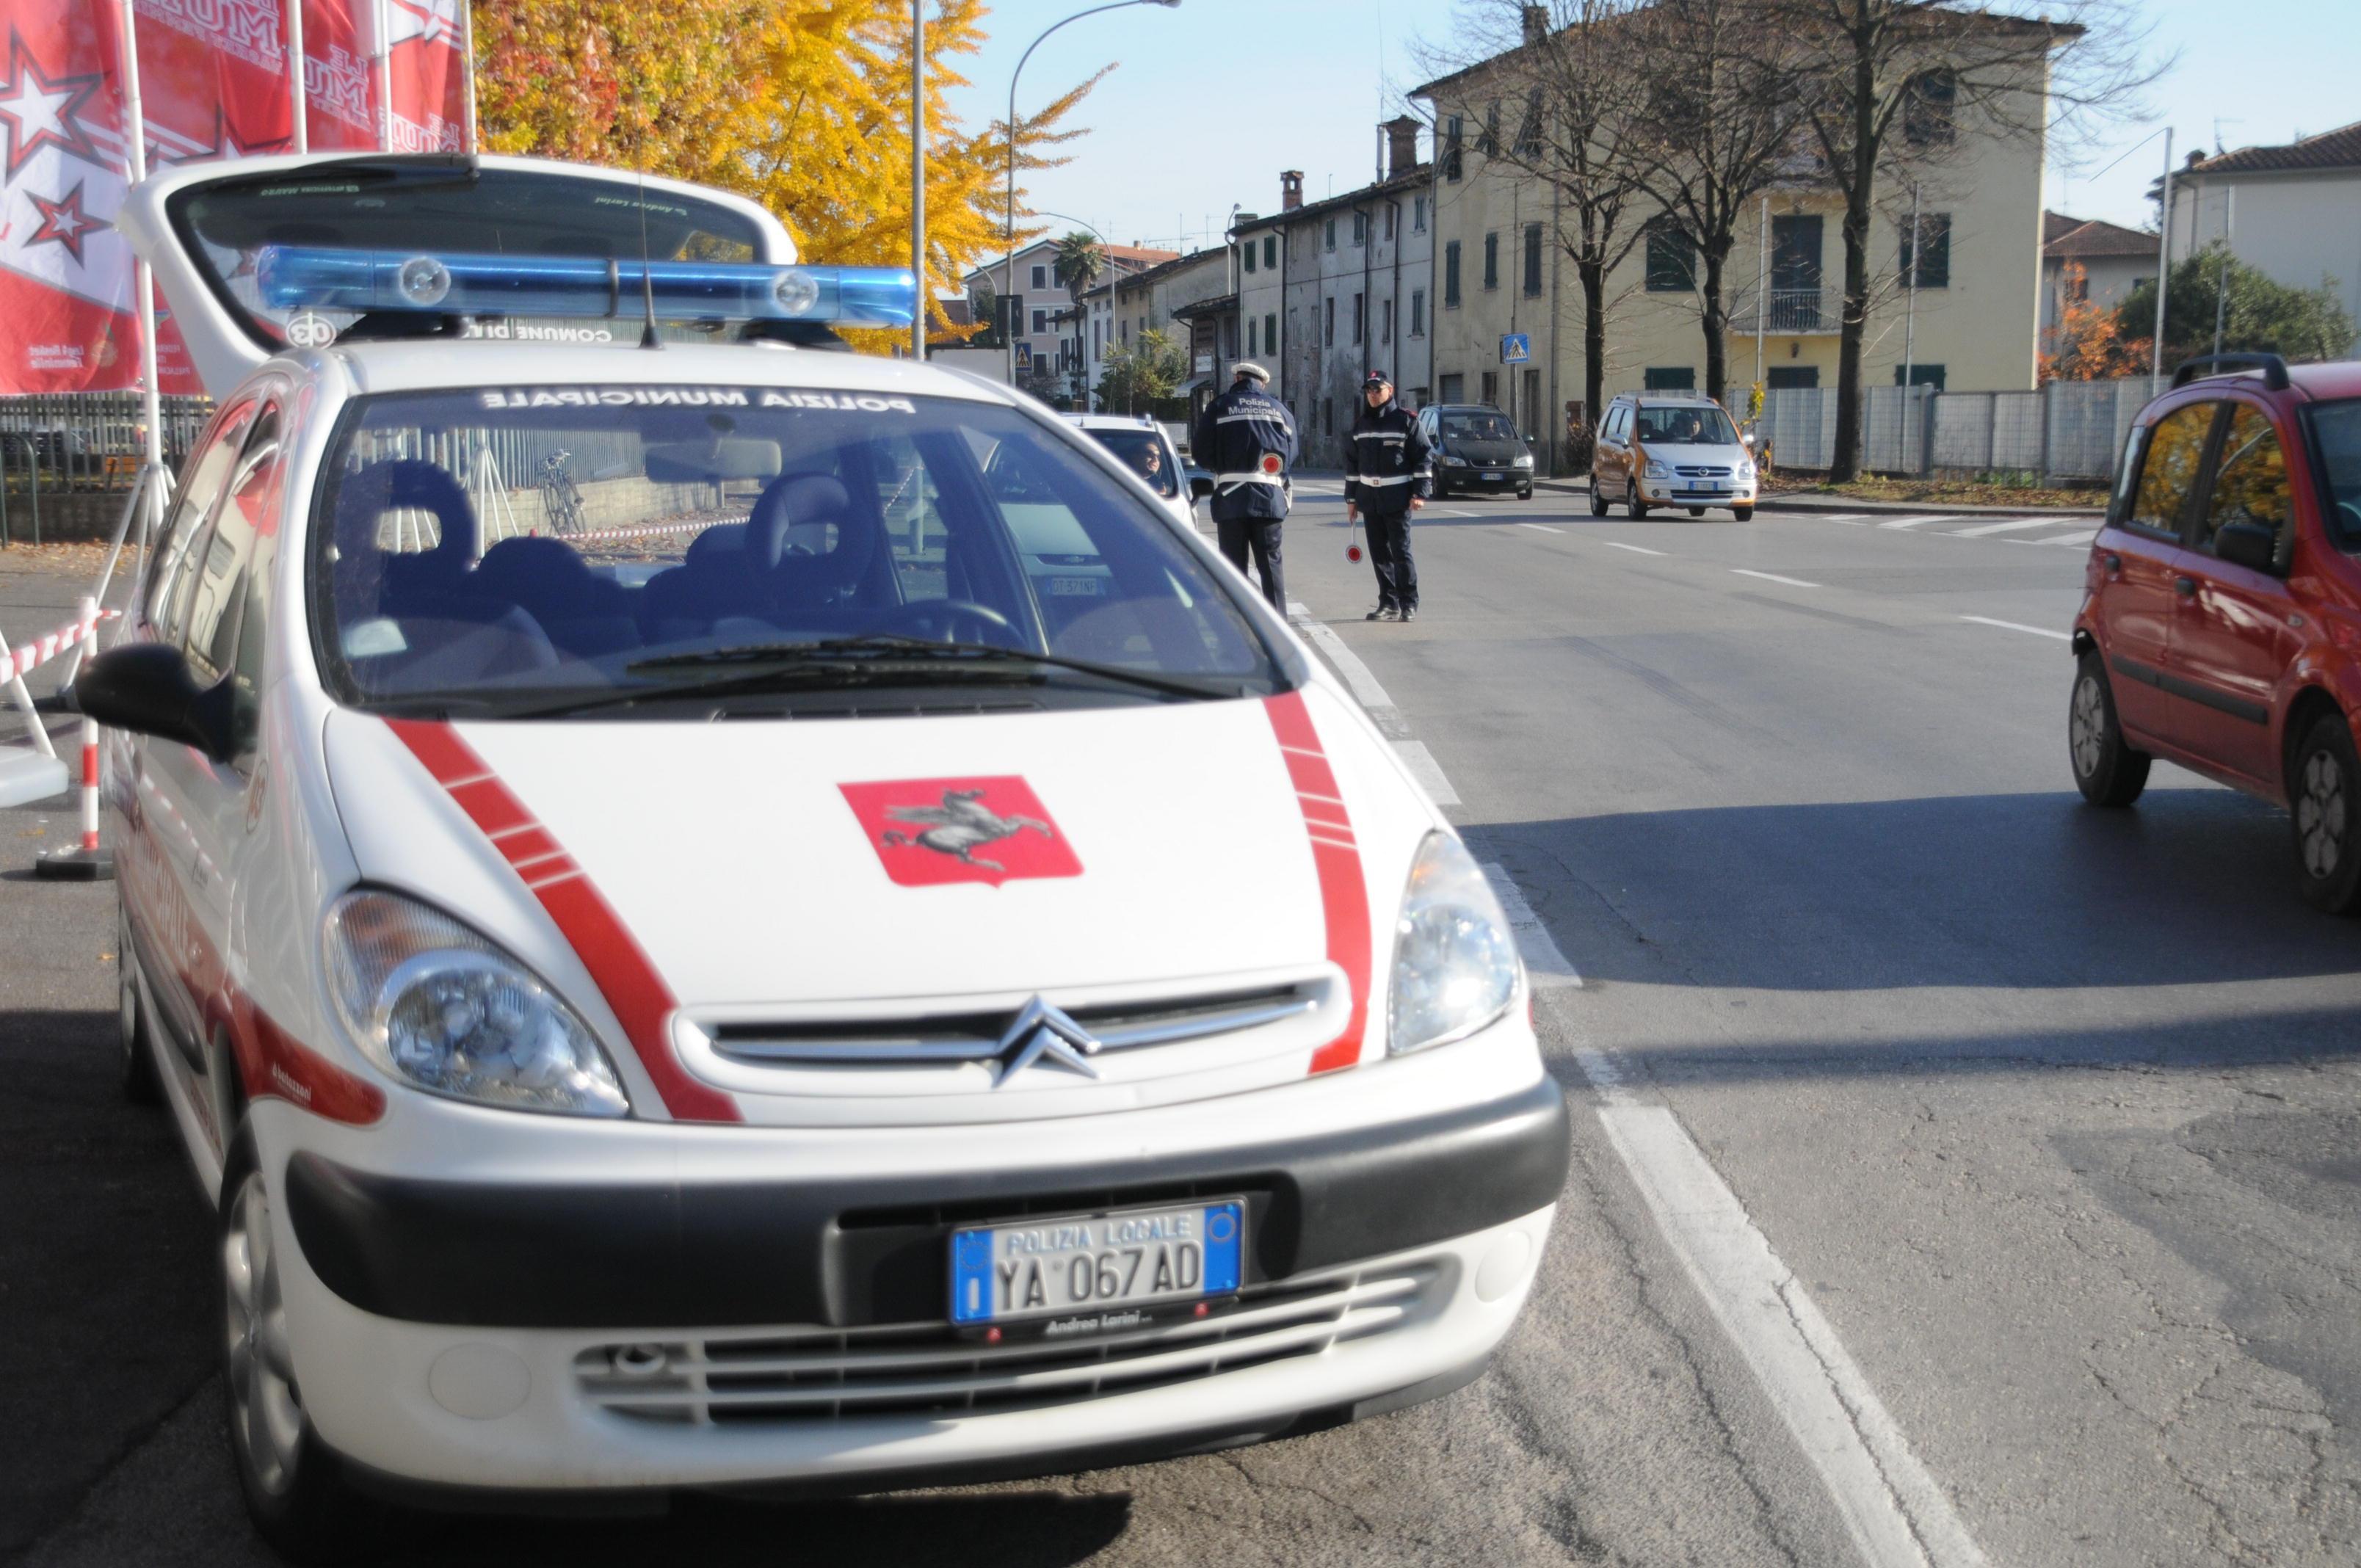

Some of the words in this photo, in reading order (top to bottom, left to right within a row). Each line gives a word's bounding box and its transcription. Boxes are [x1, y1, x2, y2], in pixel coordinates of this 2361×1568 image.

[632, 202, 674, 213] Andrea
[485, 324, 510, 339] DI
[516, 326, 612, 342] COMUNE
[1238, 398, 1271, 407] Polizia
[1227, 406, 1281, 417] Municipale
[1007, 1226, 1093, 1255] POLIZIA
[1106, 1214, 1192, 1246] LOCALE
[1045, 1317, 1099, 1336] Andrea
